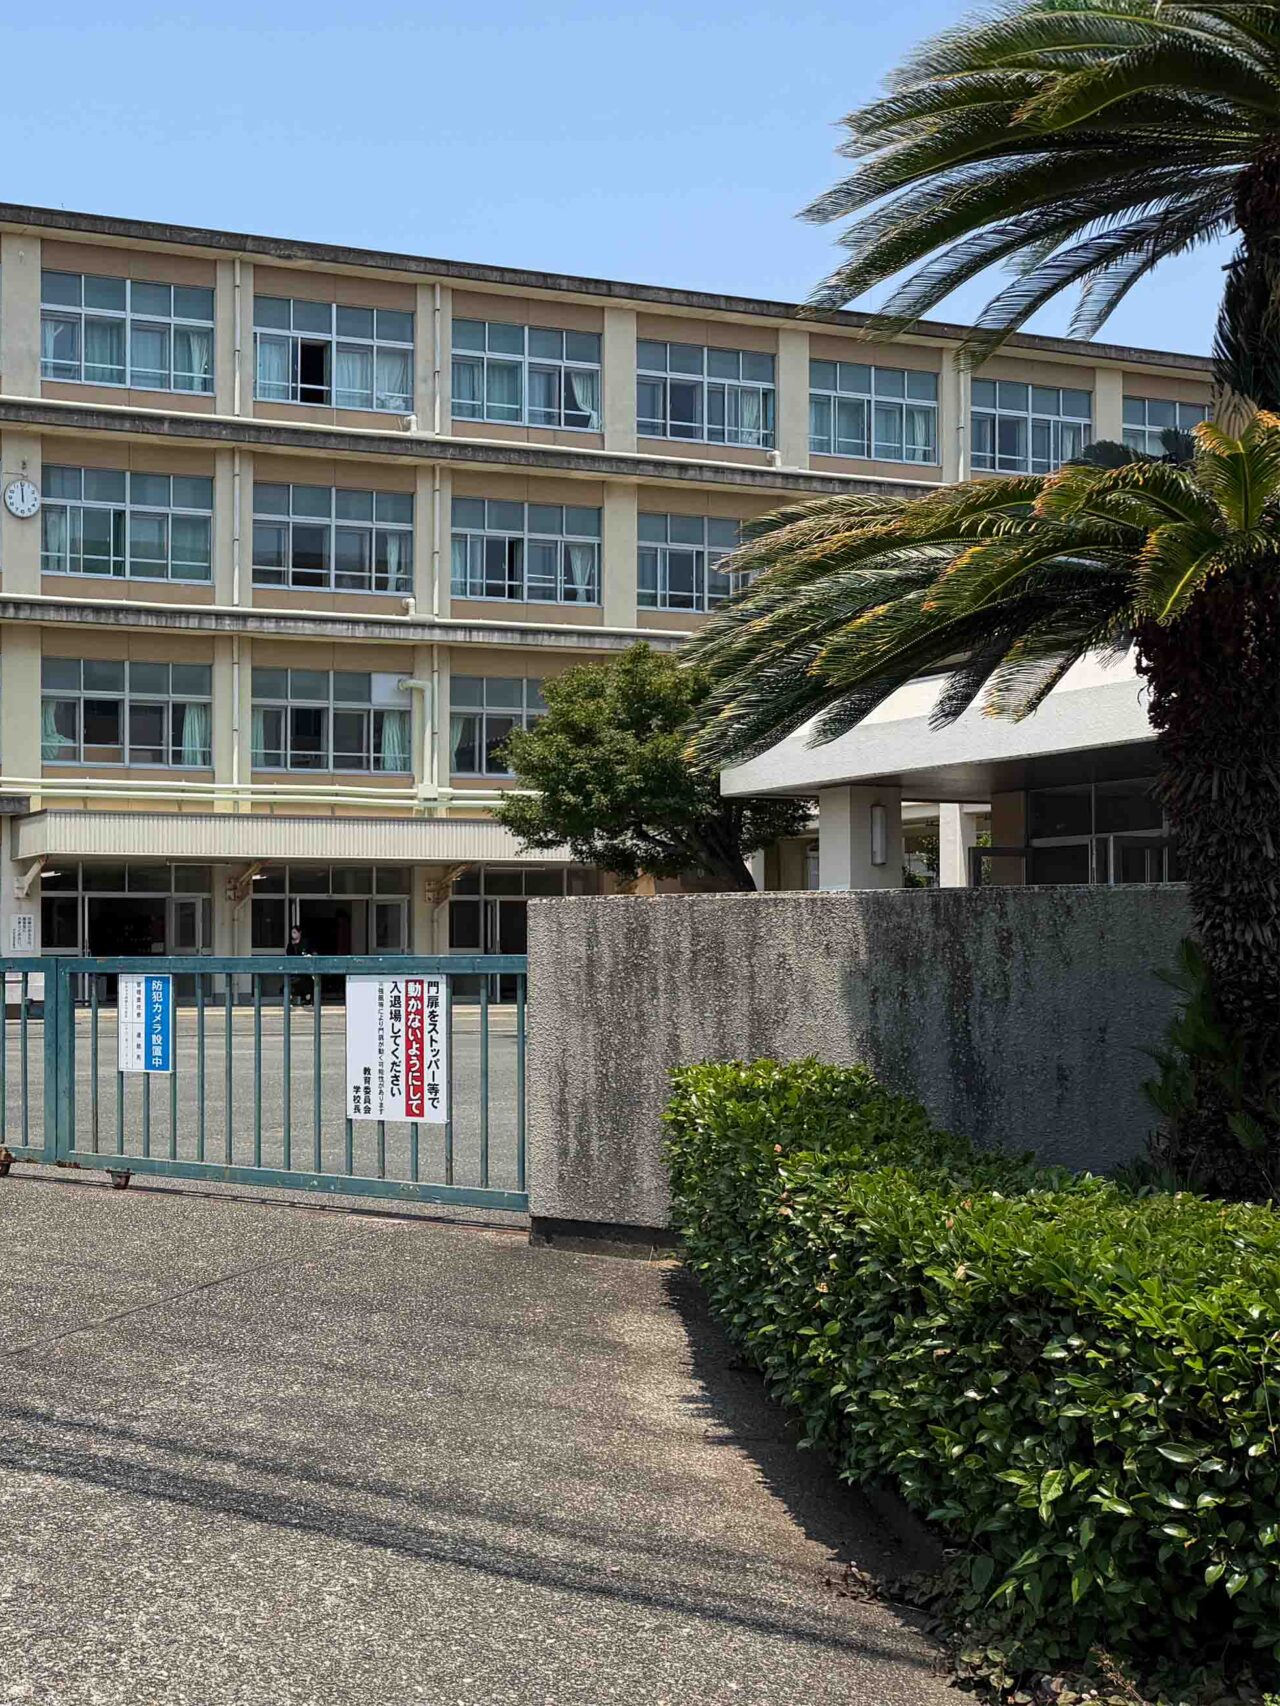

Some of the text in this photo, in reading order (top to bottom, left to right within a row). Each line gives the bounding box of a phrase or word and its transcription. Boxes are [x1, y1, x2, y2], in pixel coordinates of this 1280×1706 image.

[151, 980, 163, 1068] 防犯カメラ設置中
[389, 981, 402, 1098] 入退場してください
[407, 981, 422, 1115] 動かないようにして
[427, 981, 440, 1110] 門扉をストッパー等で
[353, 1085, 362, 1114] 学校長
[363, 1066, 372, 1115] 教育委員会
